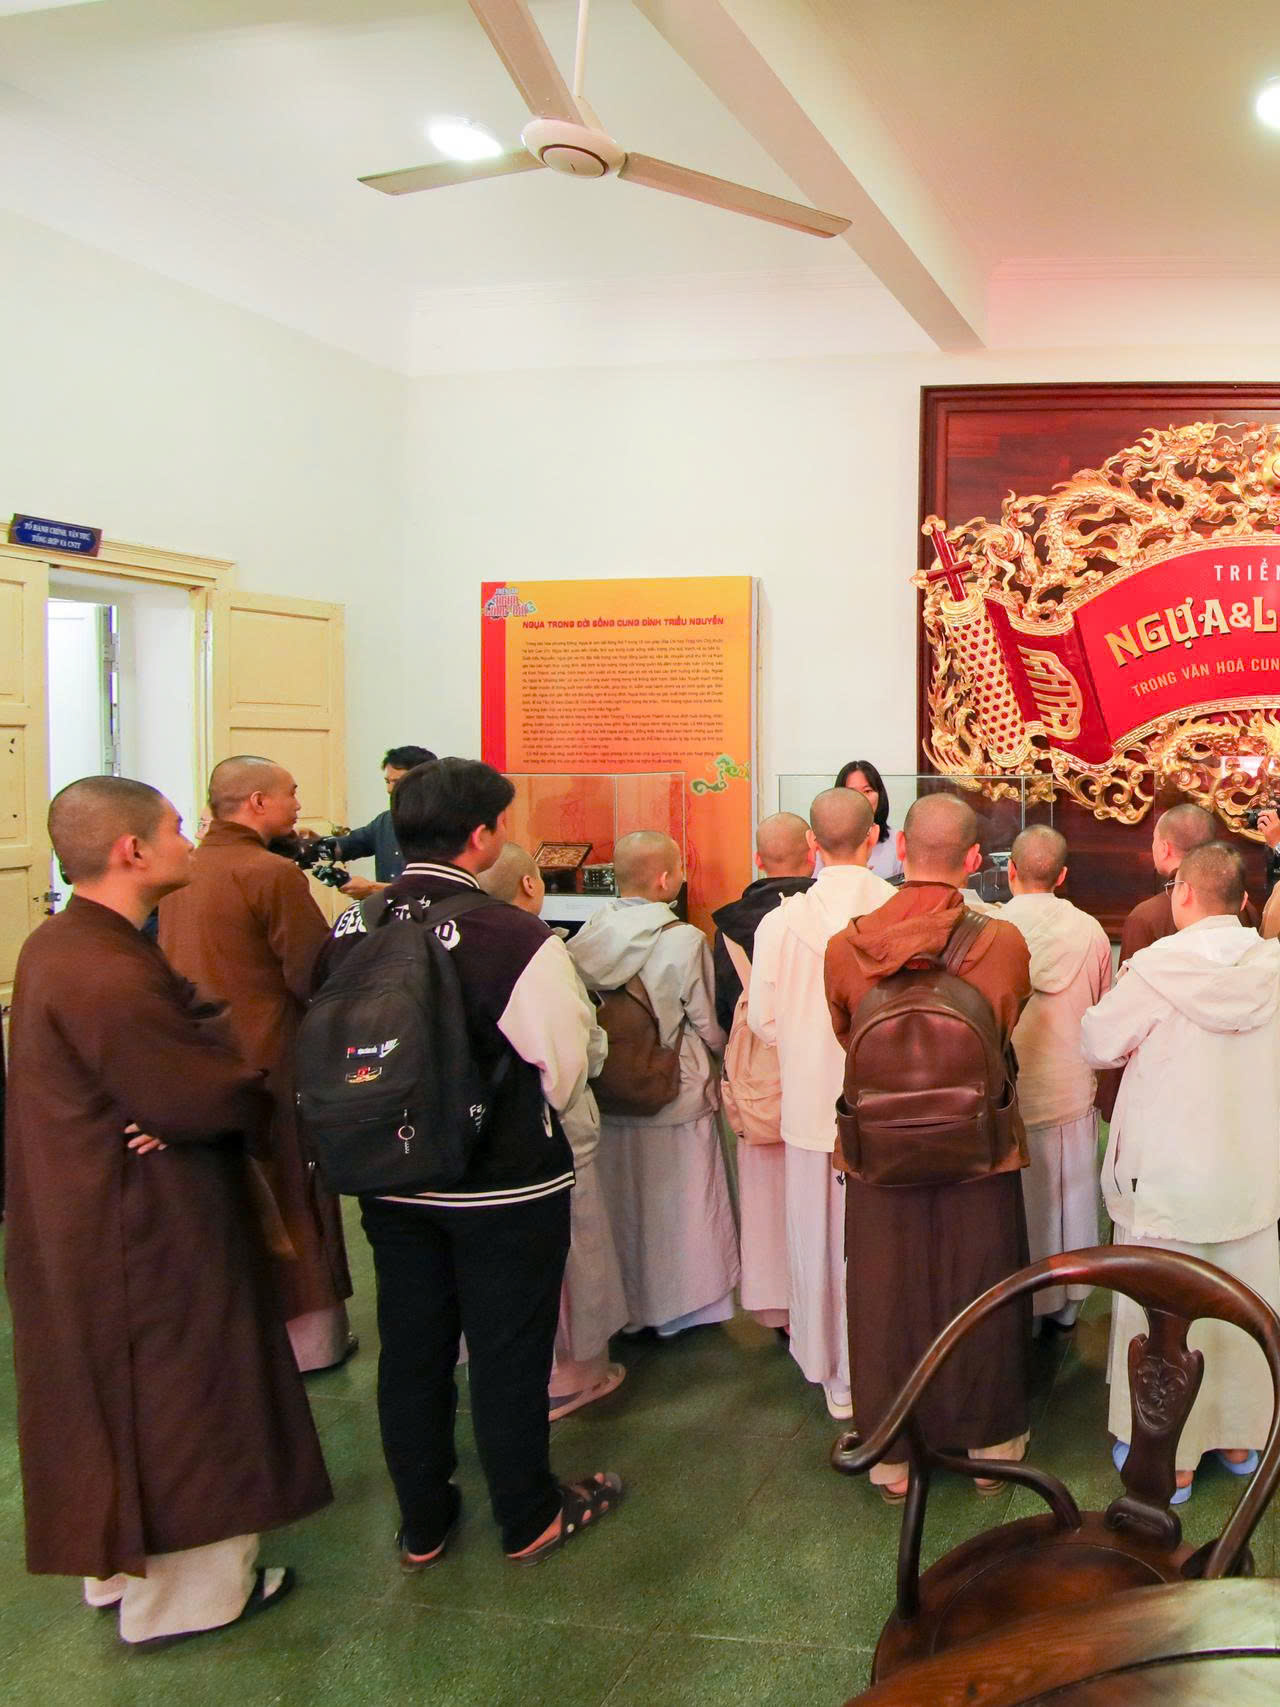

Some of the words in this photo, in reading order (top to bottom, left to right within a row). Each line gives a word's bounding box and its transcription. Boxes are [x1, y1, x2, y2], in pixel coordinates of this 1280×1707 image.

[547, 620, 575, 628] TRONG
[616, 618, 640, 627] CUNG
[1132, 671, 1177, 697] TRONG
[1182, 663, 1210, 680] VĂN
